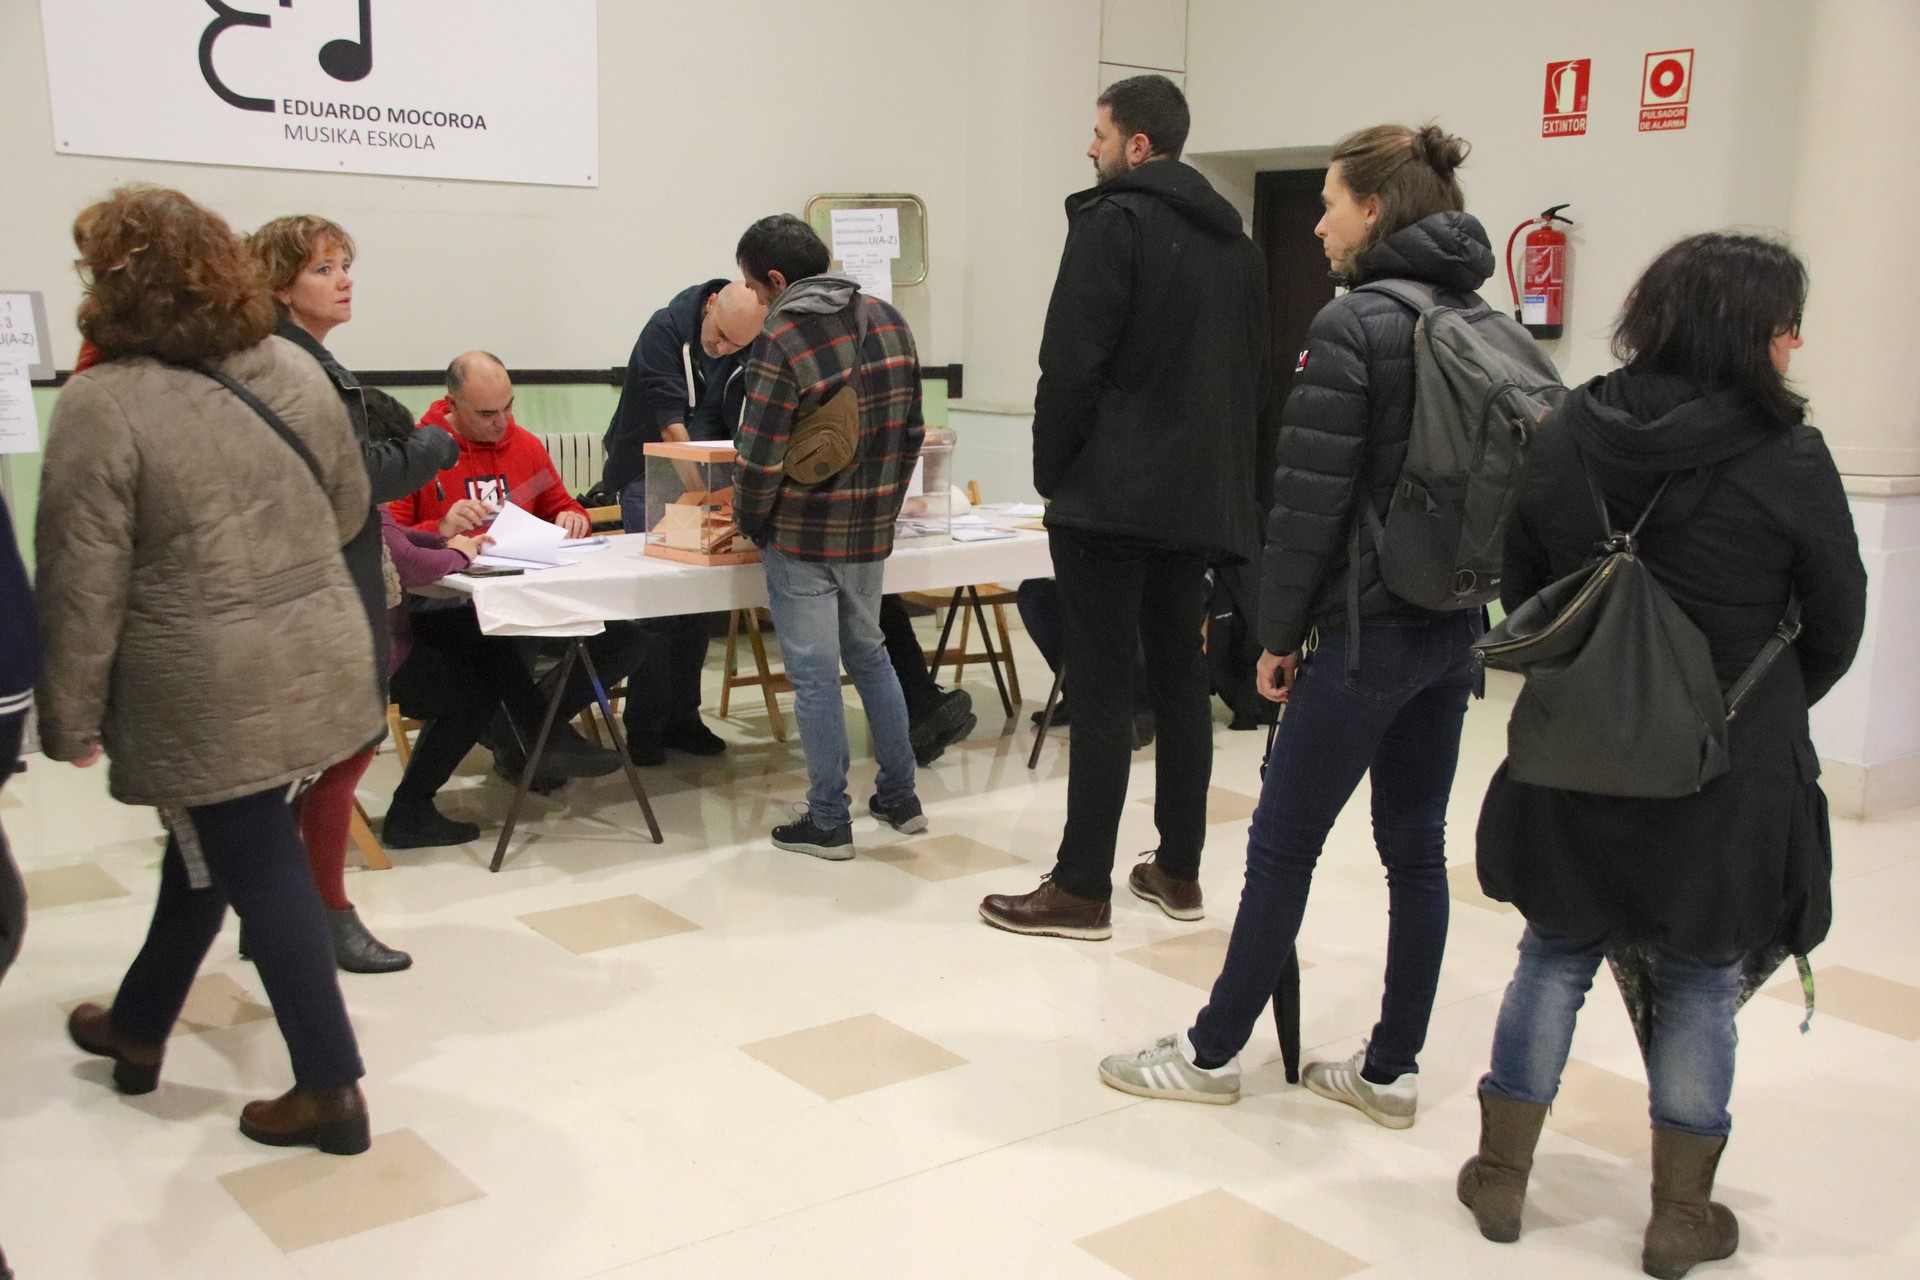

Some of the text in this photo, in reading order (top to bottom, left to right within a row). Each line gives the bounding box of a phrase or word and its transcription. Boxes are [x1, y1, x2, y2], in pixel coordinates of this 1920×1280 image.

[283, 98, 487, 130] EDUARDO MOCOROA
[1642, 109, 1685, 119] PULSADOR
[1543, 118, 1586, 134] EXTINTOR
[1639, 119, 1685, 131] DE ALARMA
[284, 124, 436, 151] MUSIKA ESKOLA
[877, 224, 883, 233] 3
[868, 236, 897, 245] U(A-Z)
[4, 317, 13, 328] 3
